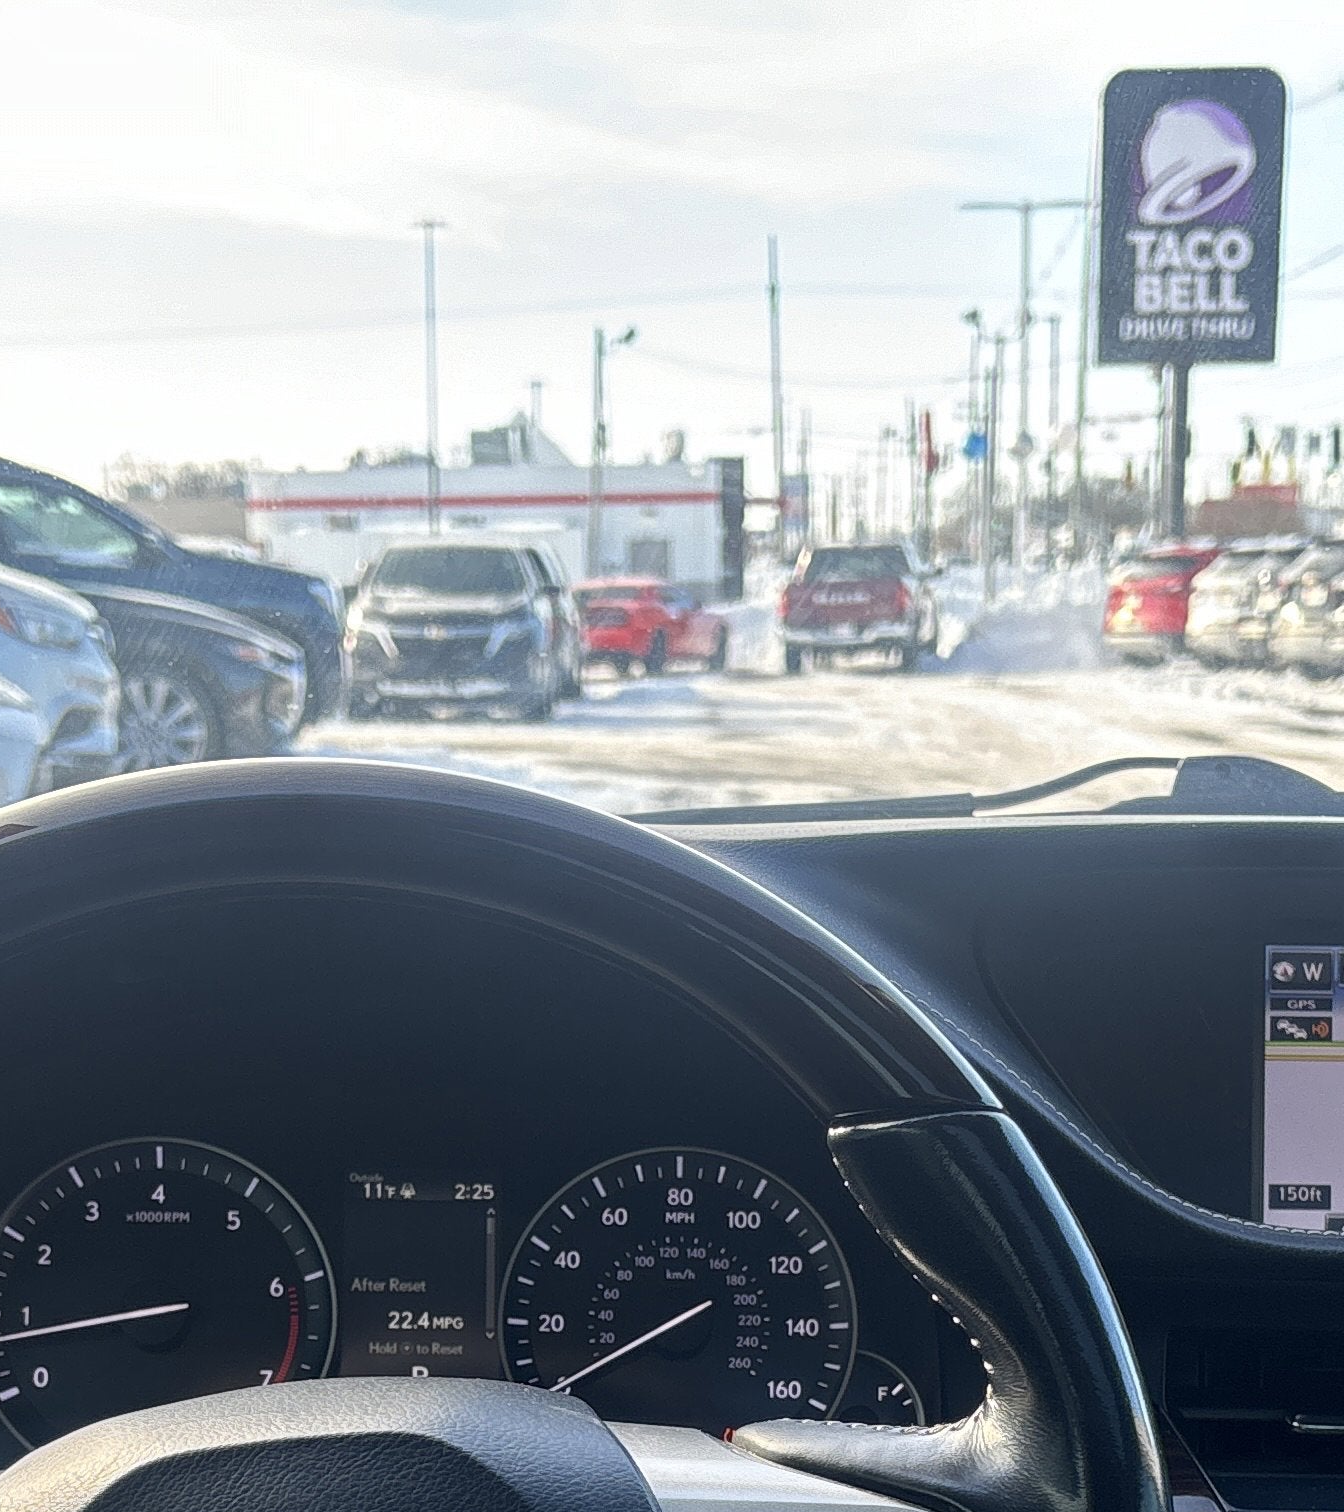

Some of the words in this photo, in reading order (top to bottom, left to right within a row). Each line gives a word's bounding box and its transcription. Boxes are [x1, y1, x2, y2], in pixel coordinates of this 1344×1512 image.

[1126, 228, 1254, 271] TACO
[1133, 273, 1250, 314] BELL
[1302, 961, 1323, 982] W
[1287, 999, 1316, 1010] GPS
[151, 1184, 166, 1205] 4
[455, 1183, 494, 1200] 2:25
[667, 1187, 693, 1206] 80
[1277, 1185, 1323, 1203] 150ft
[84, 1200, 100, 1222] 3
[601, 1207, 628, 1226] 60
[665, 1211, 695, 1224] MPH
[225, 1210, 241, 1231] 5
[726, 1211, 761, 1229] 100
[37, 1244, 52, 1266] 2
[553, 1250, 581, 1269] 40
[659, 1247, 679, 1258] 120
[686, 1247, 707, 1259] 140
[634, 1255, 655, 1268] 100
[709, 1258, 730, 1270] 160
[768, 1256, 803, 1275] 120
[616, 1269, 633, 1281] 80
[665, 1268, 696, 1280] km/h
[725, 1275, 746, 1286] 180
[269, 1276, 284, 1298] 6
[350, 1277, 386, 1292] After
[389, 1277, 426, 1293] Reset
[603, 1288, 620, 1300] 60
[733, 1294, 757, 1305] 200
[20, 1305, 30, 1327] 1
[387, 1311, 430, 1330] 22.4
[432, 1317, 464, 1330] MPG
[538, 1314, 565, 1332] 20
[597, 1309, 614, 1321] 40
[738, 1314, 761, 1326] 220
[785, 1318, 819, 1337] 140
[599, 1332, 615, 1344] 20
[736, 1336, 759, 1348] 240
[368, 1341, 398, 1355] Hold
[416, 1343, 429, 1355] to
[431, 1342, 463, 1355] Reset
[728, 1357, 751, 1369] 260
[32, 1366, 49, 1388] 0
[259, 1369, 274, 1386] 7
[766, 1380, 802, 1399] 160
[877, 1386, 889, 1402] F
